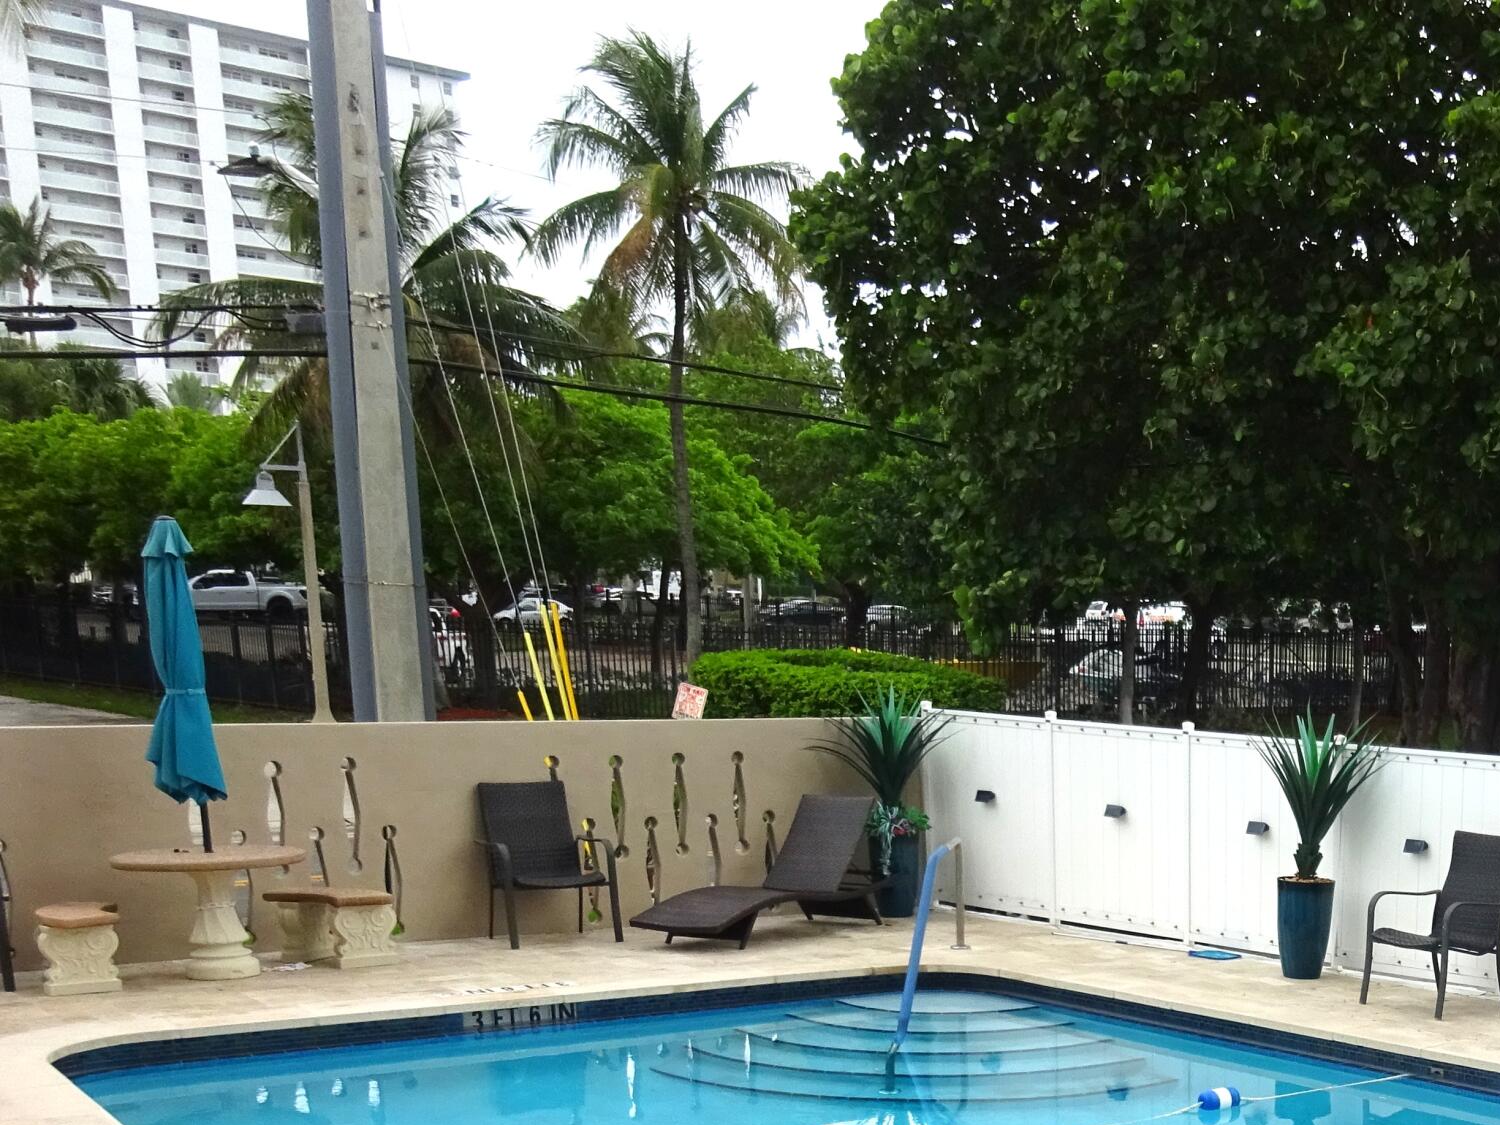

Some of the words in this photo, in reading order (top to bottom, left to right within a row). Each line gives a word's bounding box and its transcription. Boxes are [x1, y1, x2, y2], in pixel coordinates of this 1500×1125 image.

[472, 1010, 484, 1027] 3
[493, 1008, 518, 1026] FT
[529, 1005, 541, 1023] 6
[550, 1002, 576, 1022] IN
